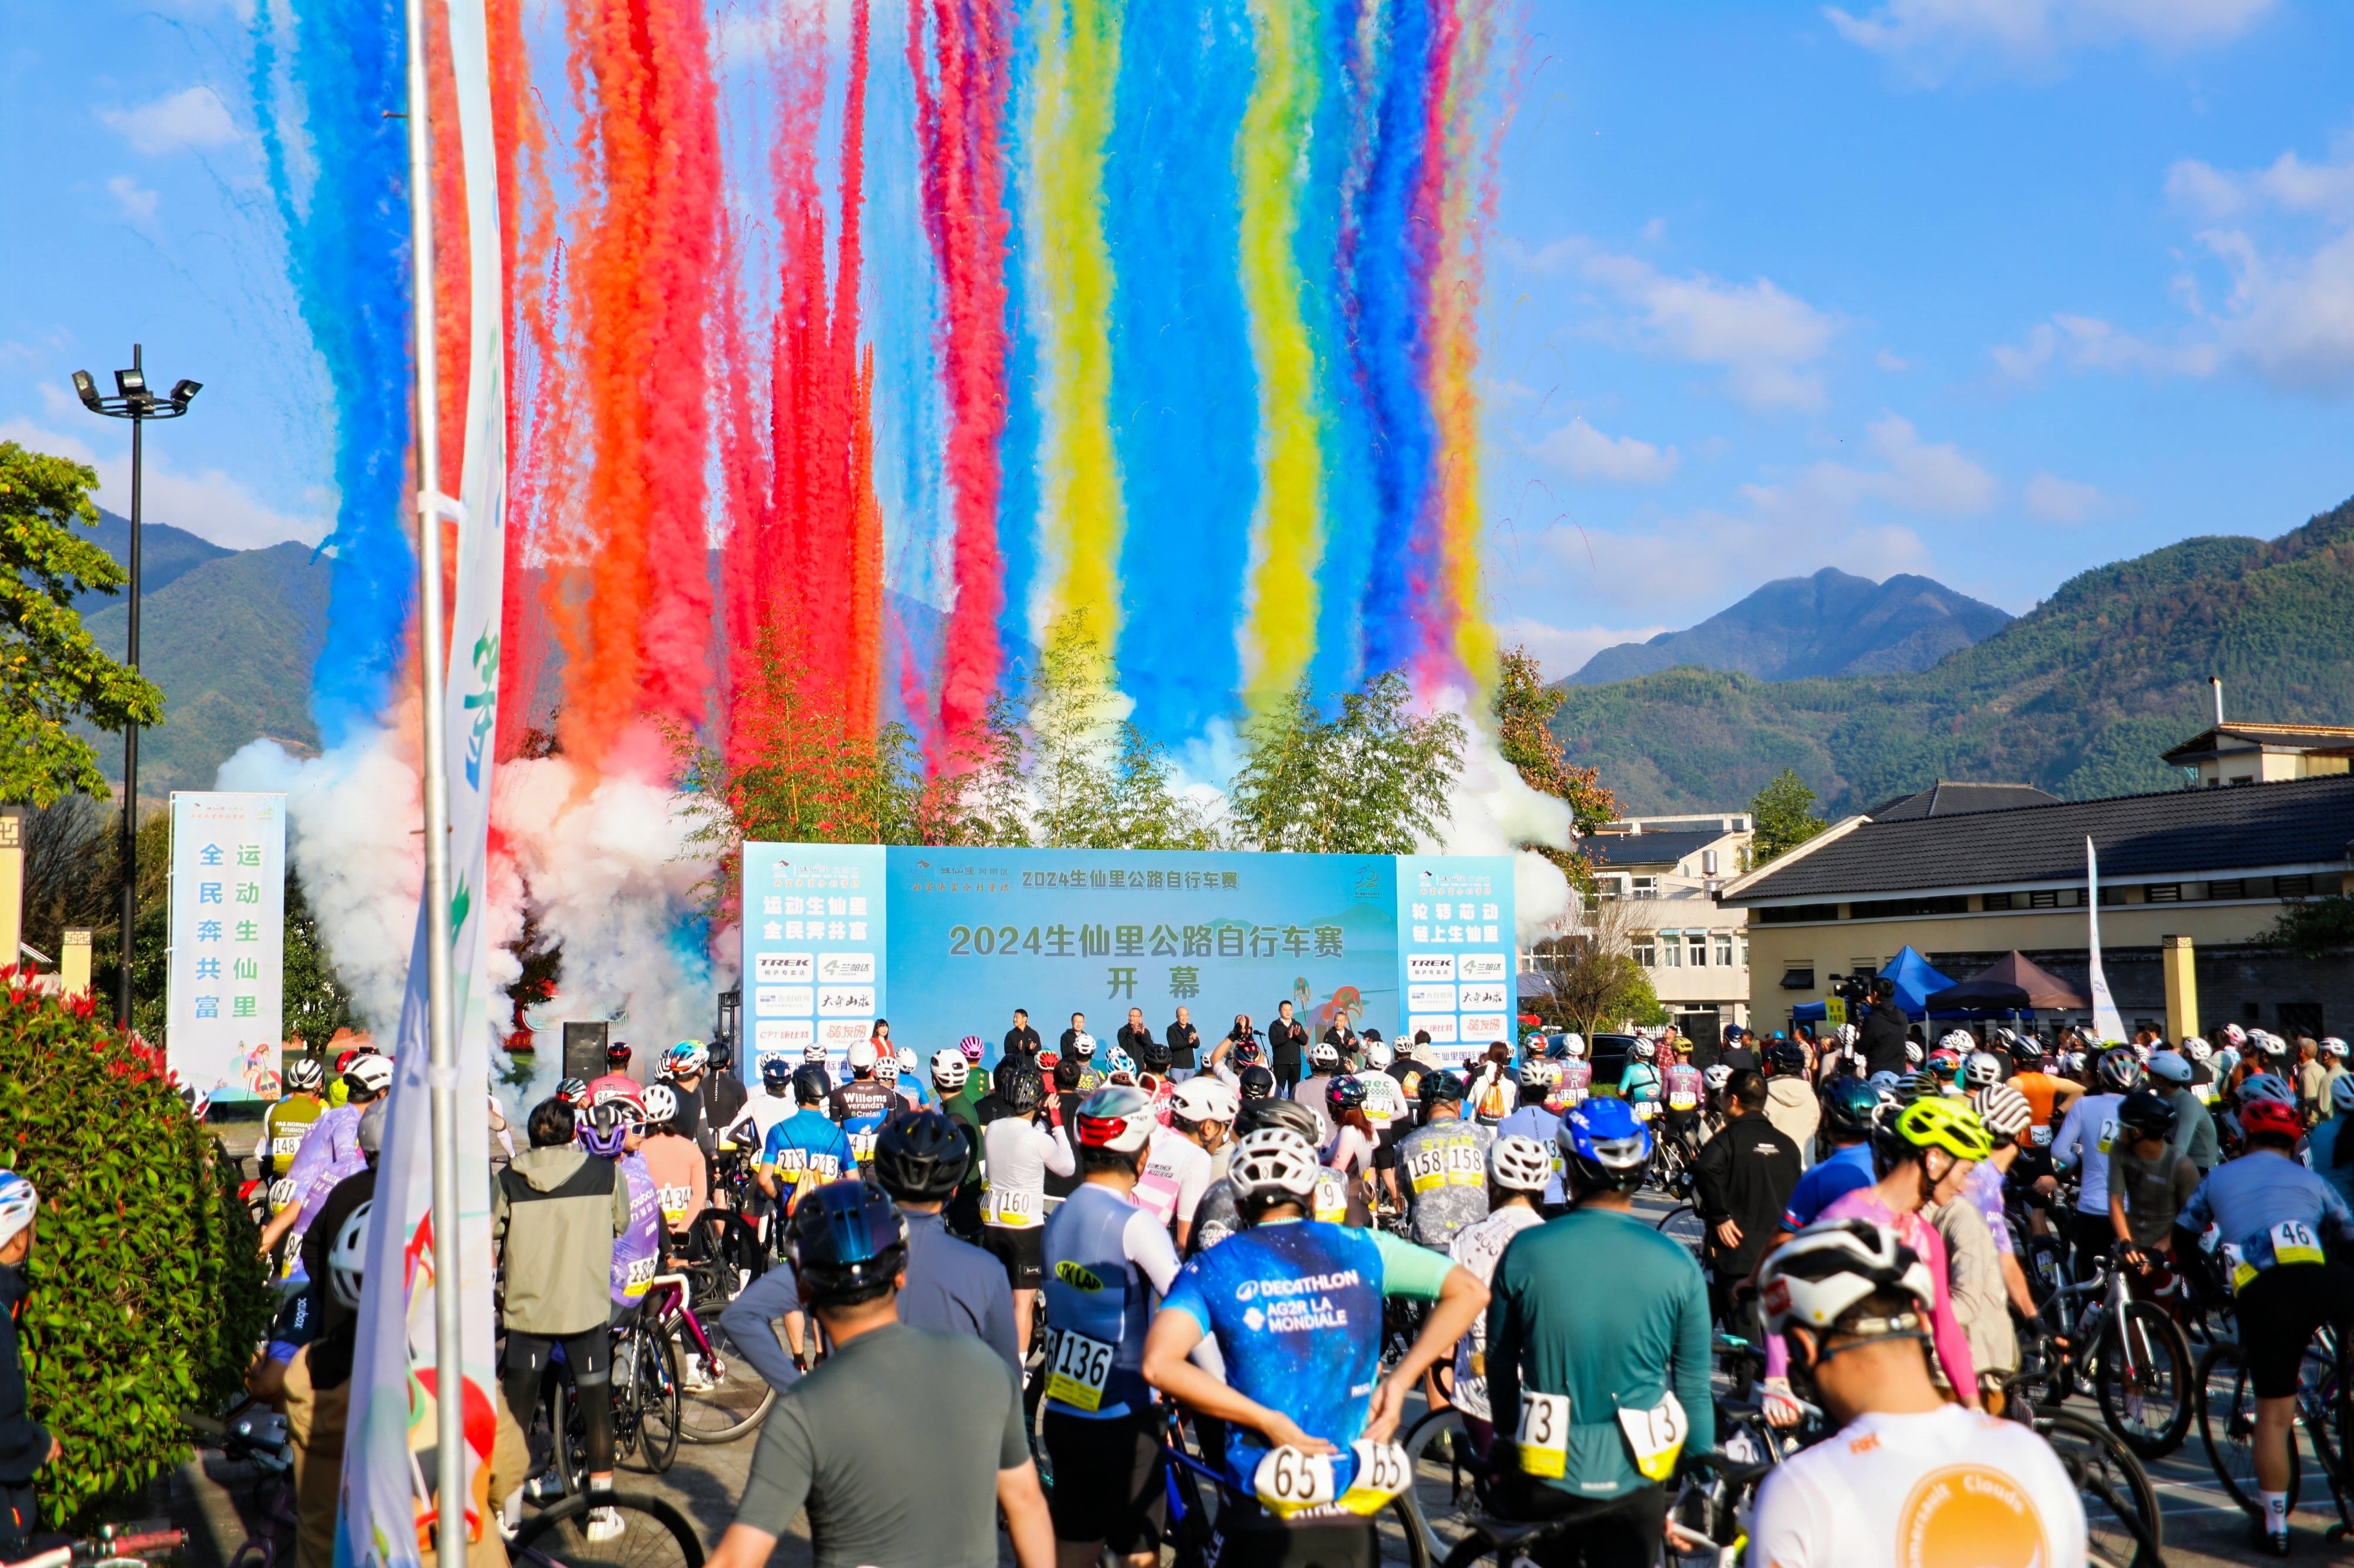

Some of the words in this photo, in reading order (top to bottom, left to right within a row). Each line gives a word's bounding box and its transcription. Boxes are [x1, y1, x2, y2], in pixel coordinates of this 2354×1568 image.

[1022, 868, 1238, 890] 2024生仙里公路自行车赛
[763, 896, 867, 916] 运动生仙里
[1412, 903, 1498, 920] 轮转芯动
[195, 843, 224, 1019] 全民奔共富
[233, 844, 261, 1017] 运动生仙里
[763, 920, 867, 940] 全民奔共富
[1413, 925, 1498, 942] 链上生仙里
[949, 924, 1344, 959] 2024生仙里公路自行车赛
[781, 1031, 808, 1039] 康比特
[827, 1025, 867, 1039] 骑友网
[1467, 1019, 1500, 1031] 骑友网
[843, 1092, 887, 1103] Willems
[1561, 1090, 1575, 1100] 128
[275, 1138, 295, 1153] 148
[780, 1151, 804, 1171] 213
[1413, 1150, 1441, 1178] 158
[1453, 1148, 1481, 1171] 158
[1149, 1170, 1173, 1178] SHEEP
[271, 1179, 294, 1204] 181
[1003, 1191, 1029, 1213] 160
[2282, 1222, 2310, 1245] 46
[1260, 1269, 1360, 1297] DECATHLON
[1267, 1300, 1308, 1317] AG2R
[1311, 1296, 1333, 1312] LA
[1268, 1308, 1348, 1334] MONDIALE
[1059, 1335, 1109, 1386] 136
[1274, 1448, 1316, 1499] 65
[1372, 1443, 1401, 1489] 65
[1962, 1473, 2027, 1515] Clouds
